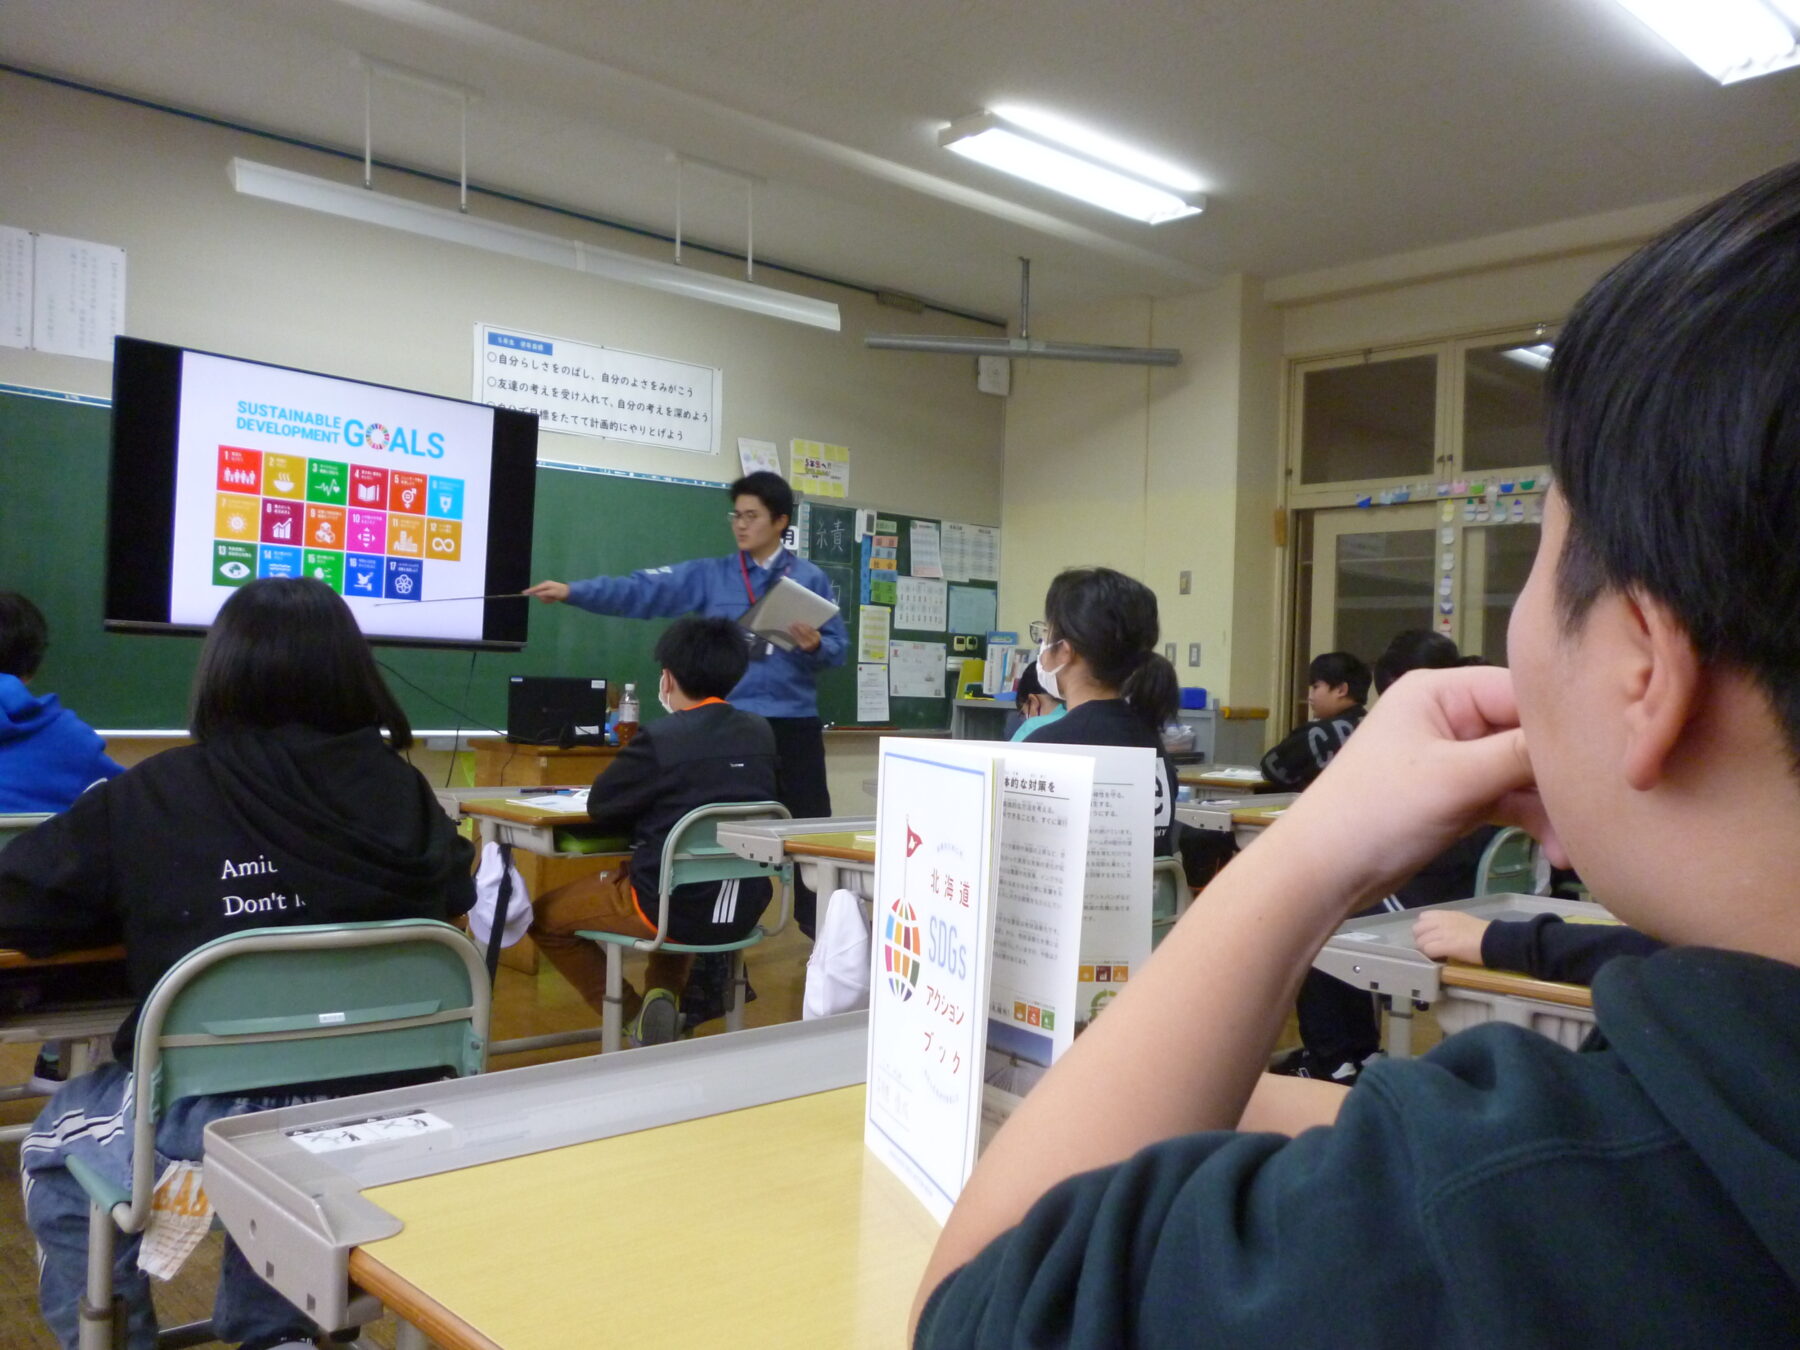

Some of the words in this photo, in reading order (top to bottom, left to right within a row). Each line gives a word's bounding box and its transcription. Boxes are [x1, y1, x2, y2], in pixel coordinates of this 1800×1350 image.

[237, 400, 341, 430] SUSTAINABLE
[236, 416, 340, 445] DEVELOPMENT
[343, 419, 445, 459] GOALS
[222, 891, 288, 916] Don't
[930, 868, 971, 908] 北海道
[929, 915, 967, 981] SDGs
[926, 984, 965, 1025] アクション
[924, 1031, 961, 1074] ブック
